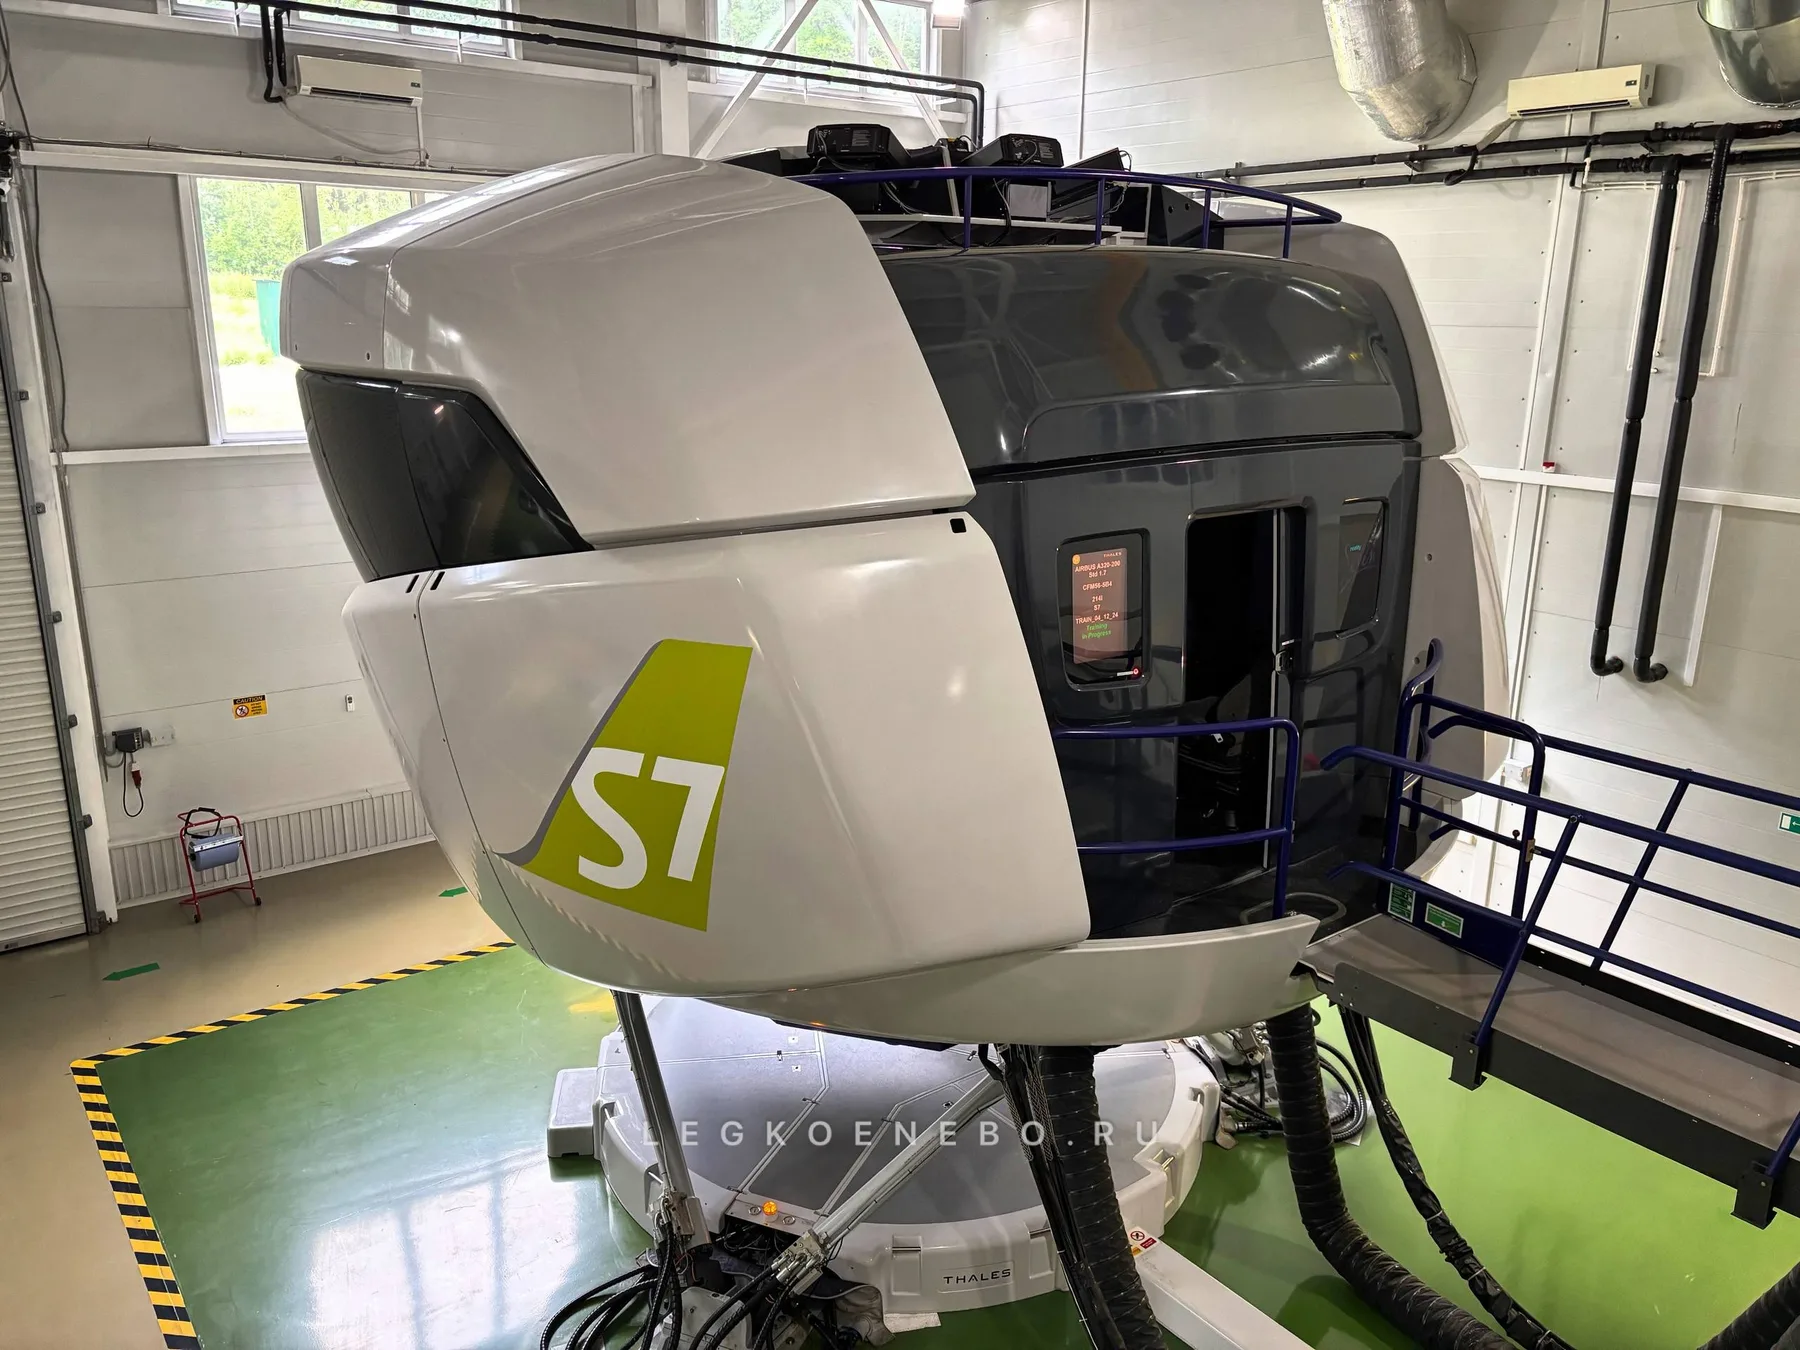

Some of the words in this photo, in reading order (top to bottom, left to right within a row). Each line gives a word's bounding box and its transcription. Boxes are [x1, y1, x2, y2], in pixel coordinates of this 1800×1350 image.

[1075, 563, 1096, 573] AIRBUS
[1097, 560, 1120, 569] A320-200
[1088, 630, 1111, 639] Progress
[571, 747, 725, 889] S7
[943, 1268, 1011, 1284] THALES
